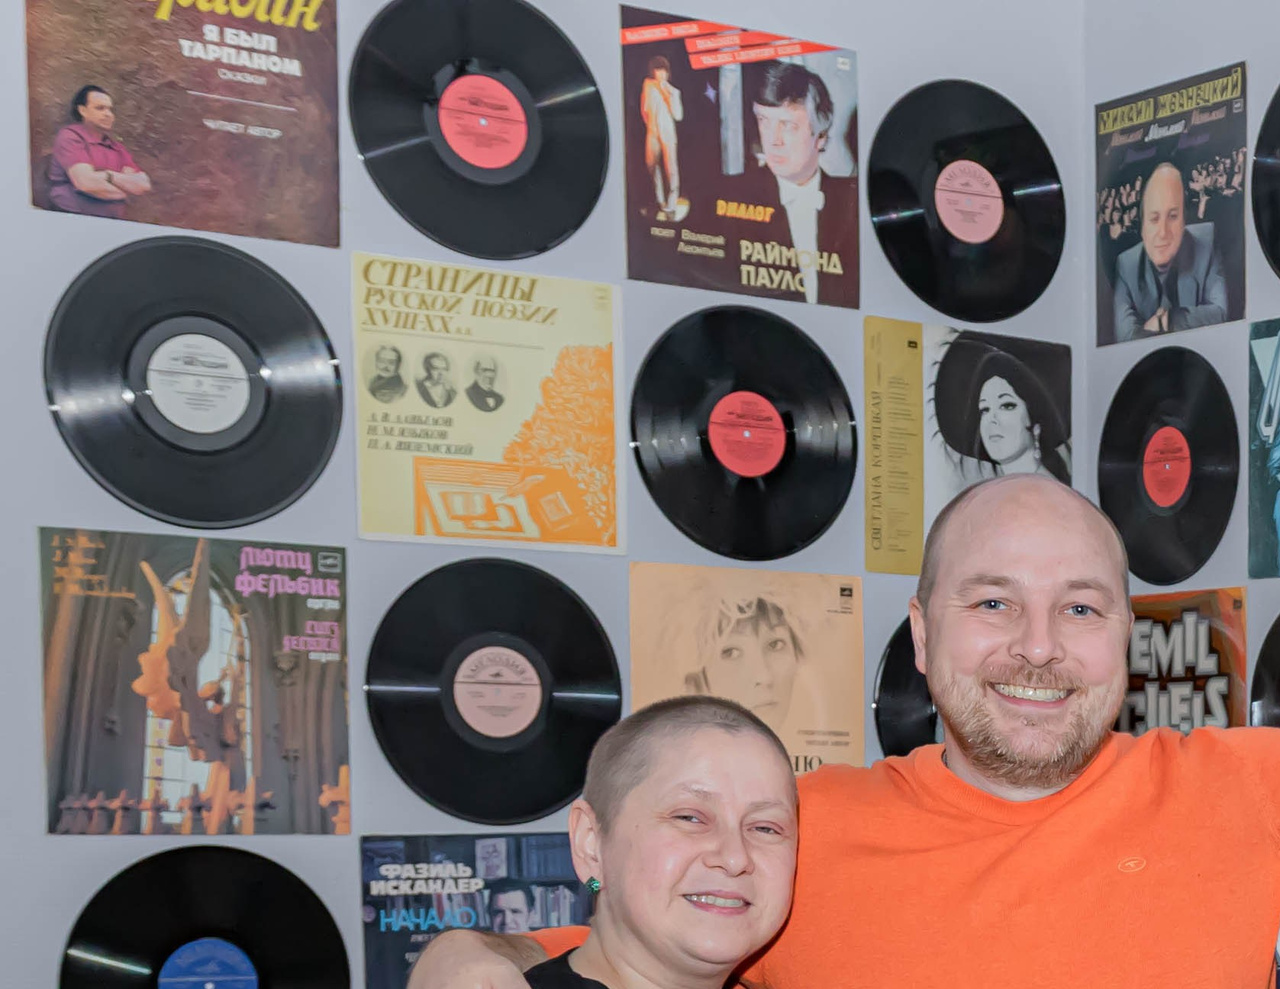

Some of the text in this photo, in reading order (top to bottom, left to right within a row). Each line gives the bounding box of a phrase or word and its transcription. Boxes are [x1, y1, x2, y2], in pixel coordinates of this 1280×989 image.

[178, 39, 303, 77] ТАРПАНОМ
[362, 258, 538, 302] СТРАНИЦЫ
[379, 863, 473, 879] ФАЗИЛЬ
[370, 878, 485, 896] ИСКАНДЕР
[379, 906, 477, 932] НАЧАЛО
